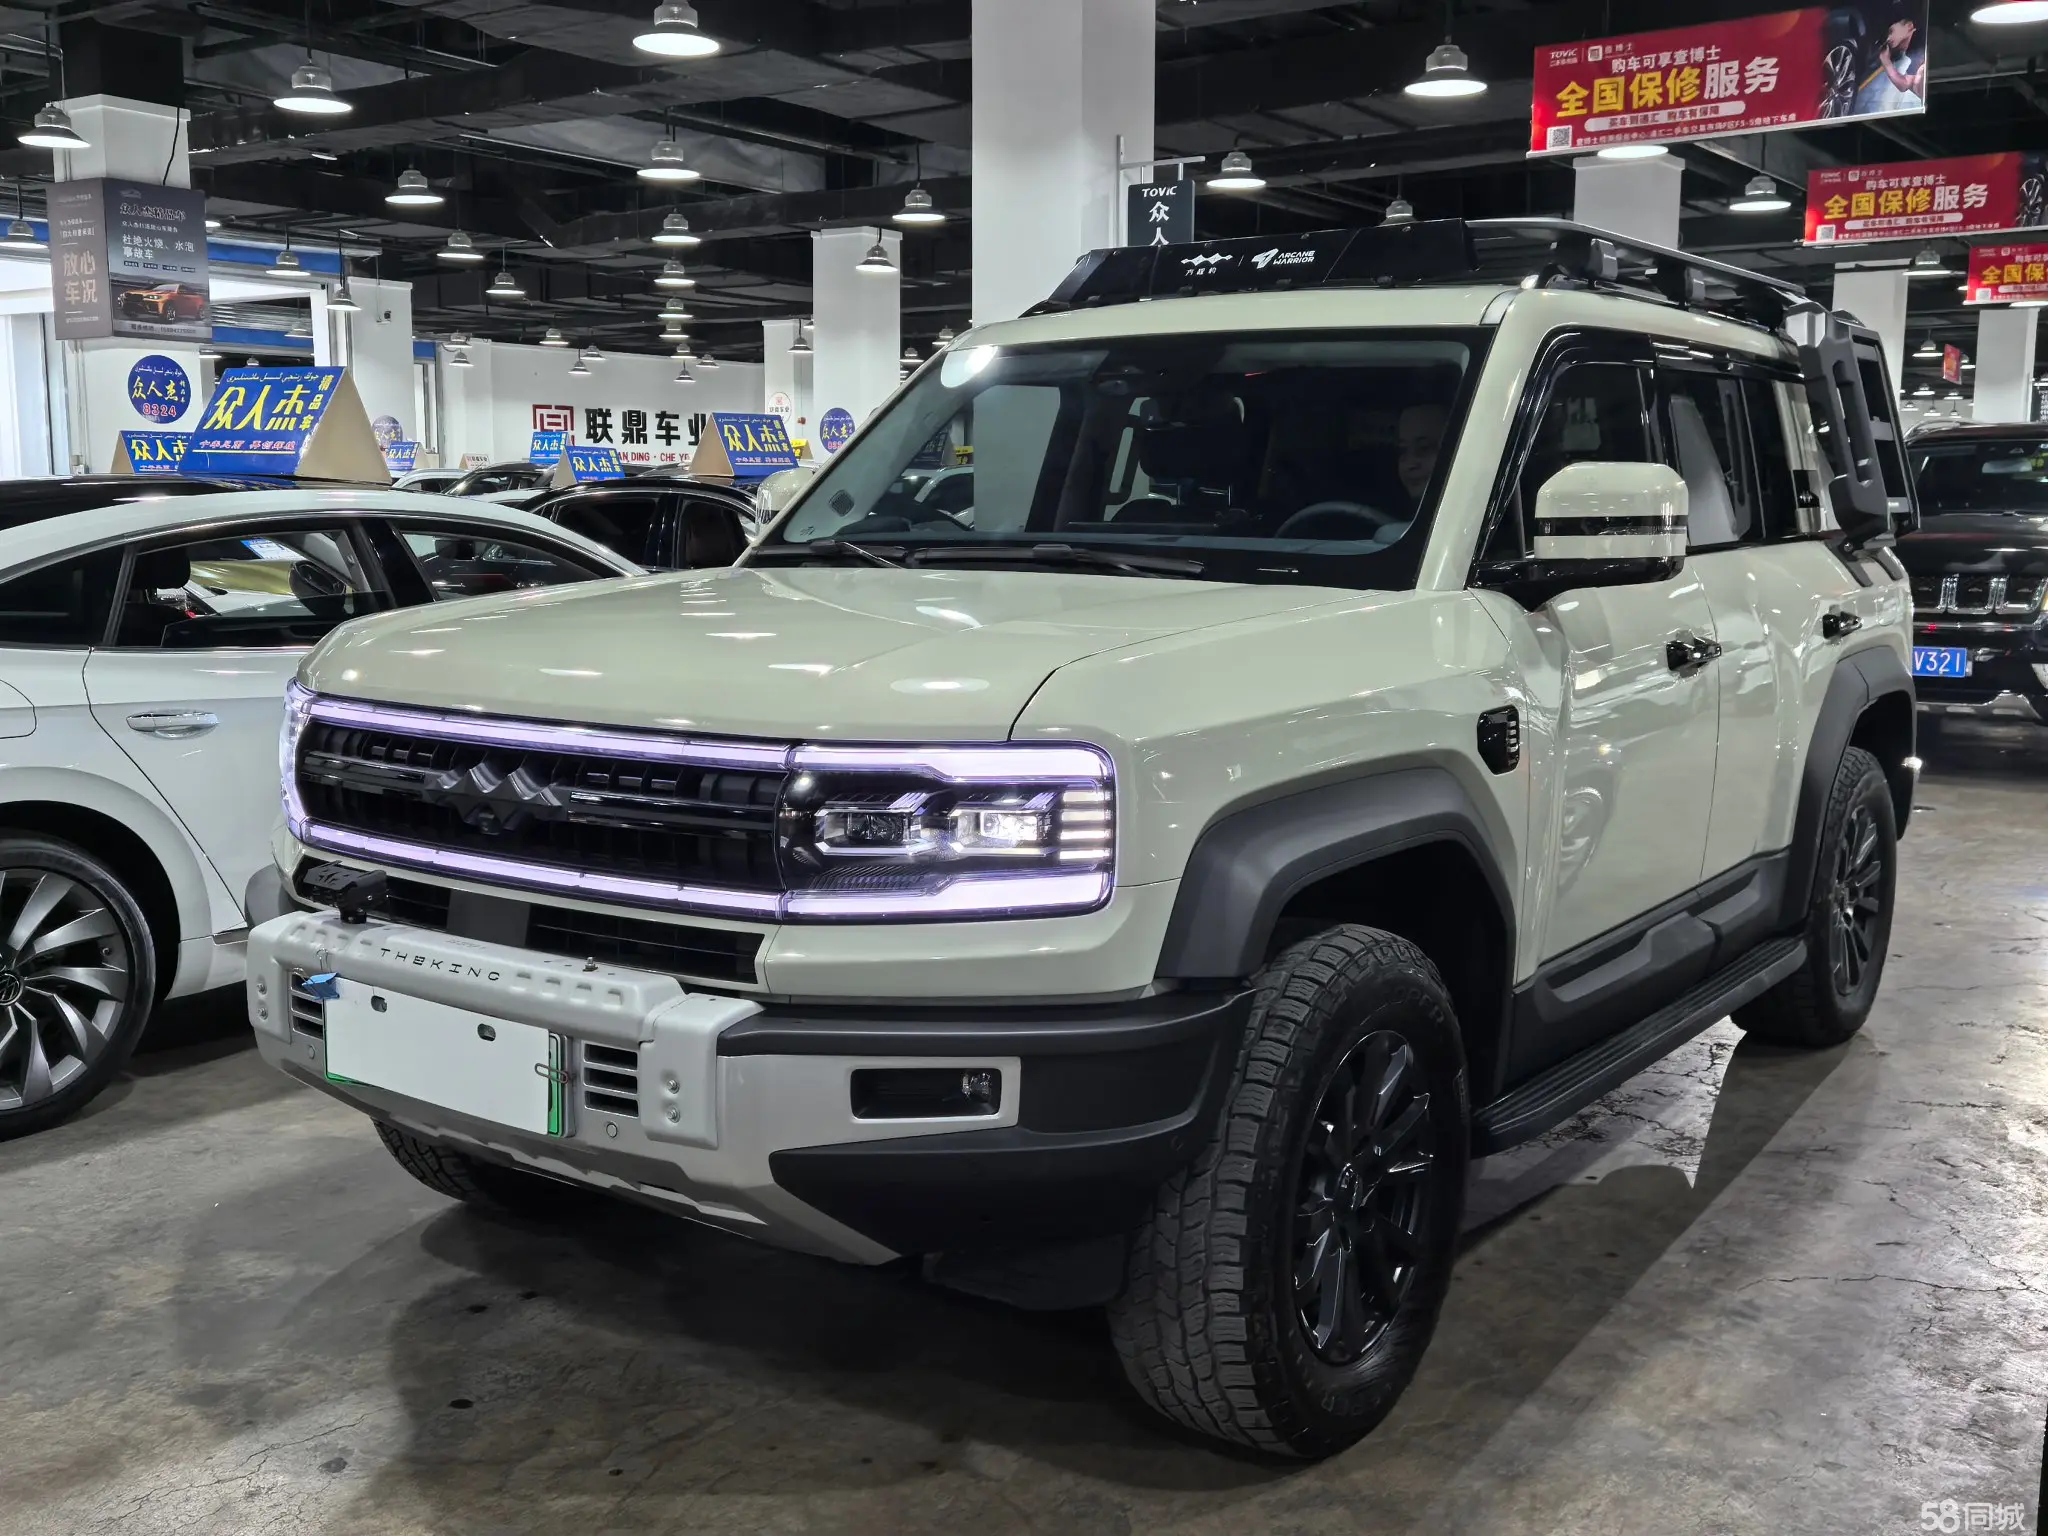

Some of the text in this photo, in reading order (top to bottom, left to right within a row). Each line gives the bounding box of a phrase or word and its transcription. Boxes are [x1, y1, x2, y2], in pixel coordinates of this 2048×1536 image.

[1611, 45, 1721, 74] 购车可享查博士
[1556, 56, 1780, 118] 全国保修服务
[1823, 184, 1988, 220] 全国保修服务
[62, 250, 96, 277] 放心
[1272, 256, 1315, 265] WARRIOR
[1278, 250, 1316, 259] ARCANE
[1981, 262, 2048, 285] 全国保
[63, 279, 98, 305] 车况
[131, 375, 179, 401] 众人杰
[142, 402, 177, 418] 8324
[202, 384, 311, 431] 众人杰
[723, 424, 782, 452] 众人杰
[821, 423, 849, 440] 众人杰
[532, 439, 559, 451] 众人杰
[631, 452, 650, 461] DING
[660, 453, 676, 462] CHE
[573, 457, 613, 472] 众人杰
